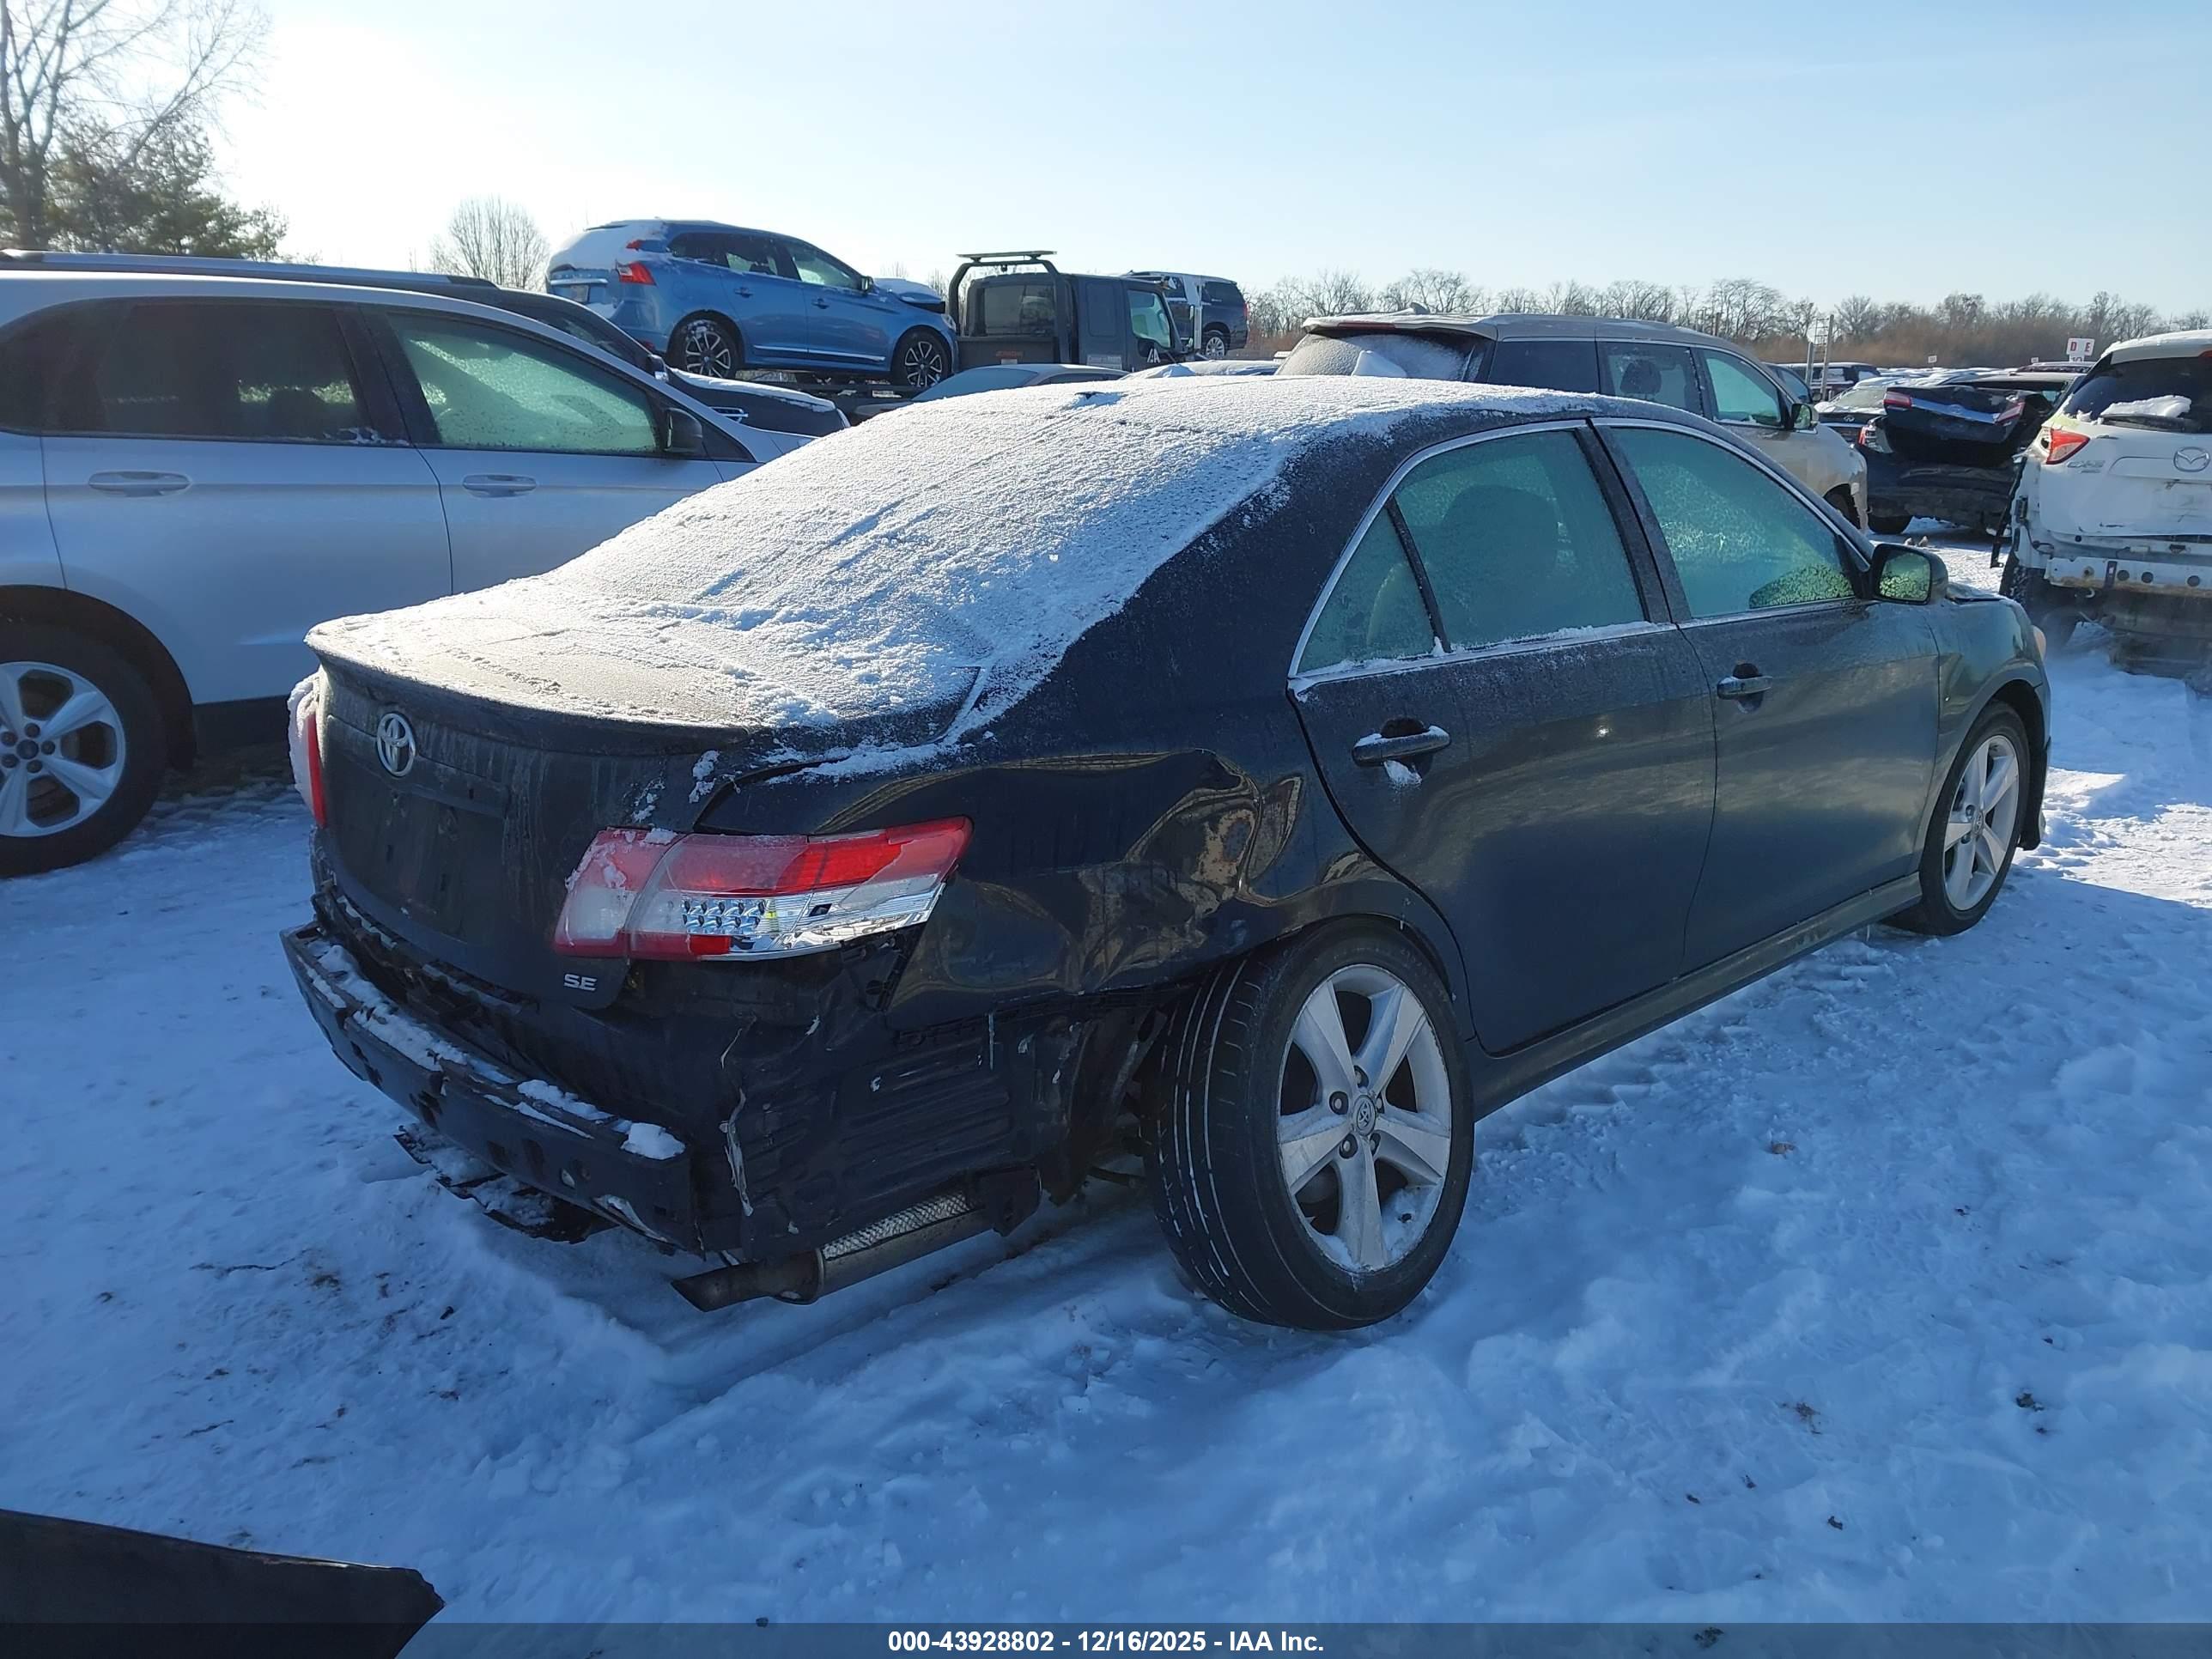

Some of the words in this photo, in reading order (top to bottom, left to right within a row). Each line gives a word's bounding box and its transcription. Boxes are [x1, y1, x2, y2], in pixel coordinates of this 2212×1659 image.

[2070, 342, 2077, 351] D
[2085, 343, 2091, 352] E
[563, 973, 598, 992] SE
